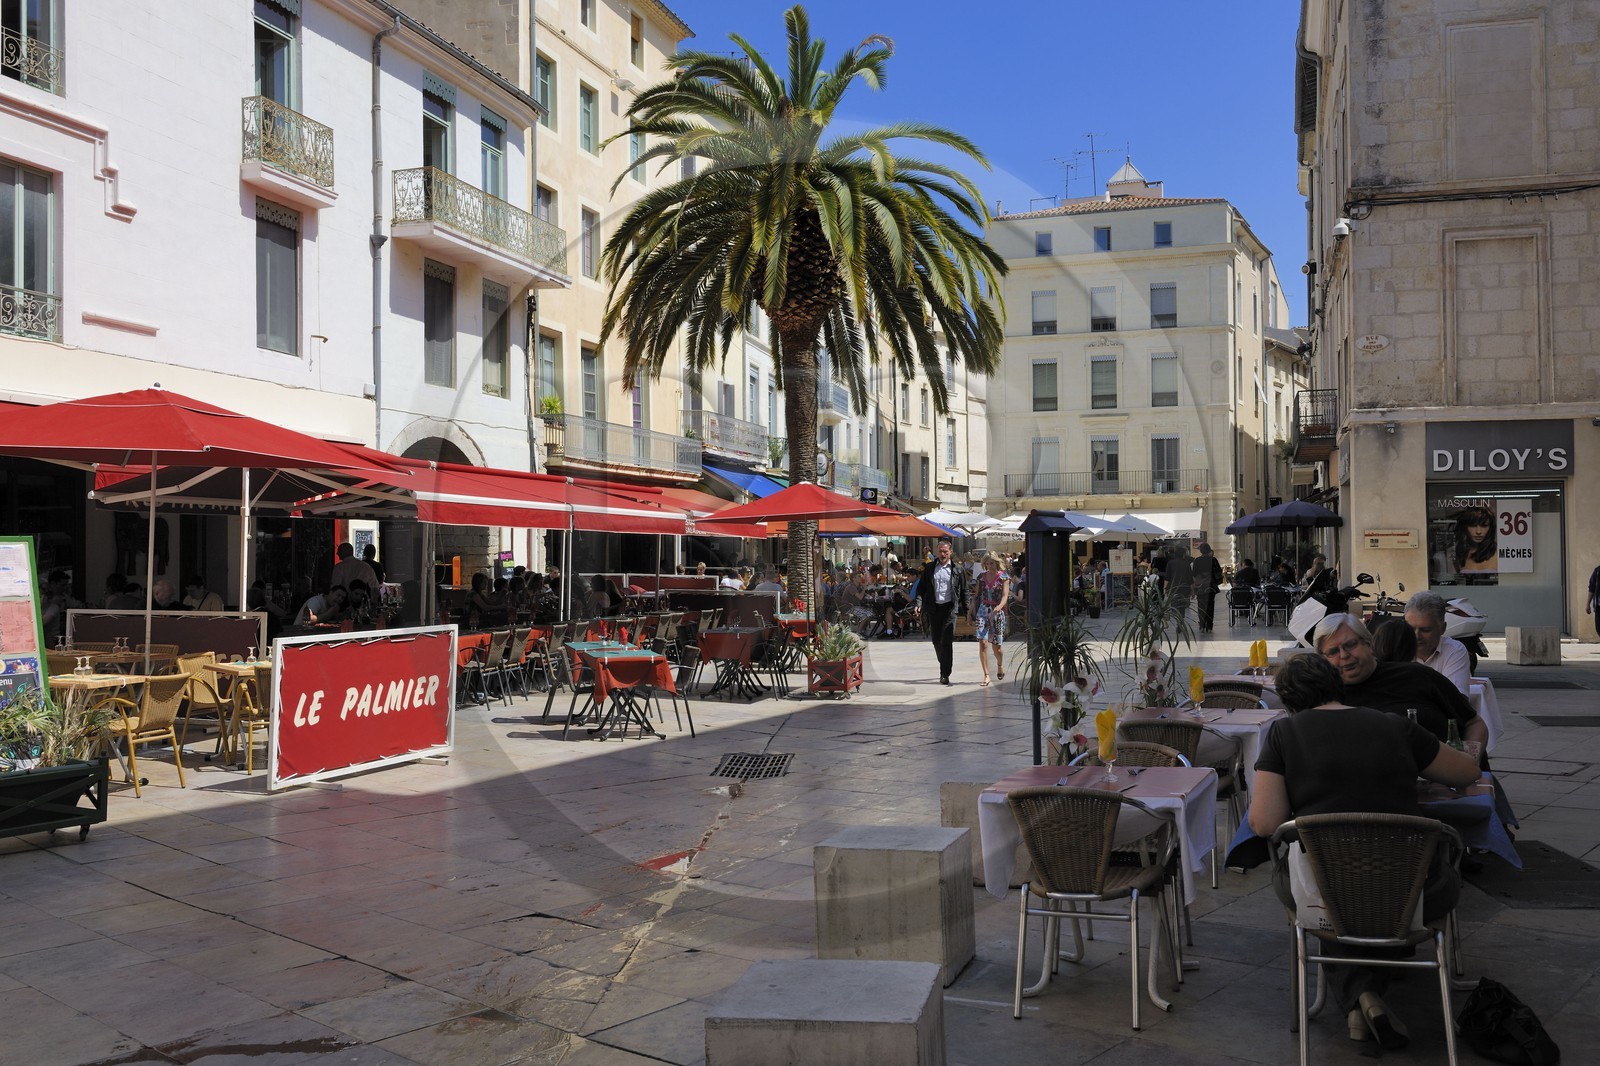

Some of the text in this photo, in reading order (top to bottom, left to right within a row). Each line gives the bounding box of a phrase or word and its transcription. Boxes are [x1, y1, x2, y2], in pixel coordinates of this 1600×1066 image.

[1433, 448, 1568, 472] DILOY'S
[1437, 498, 1490, 508] MASCULIN
[1499, 547, 1532, 558] MÈCHES
[294, 675, 440, 727] LE PALMIER
